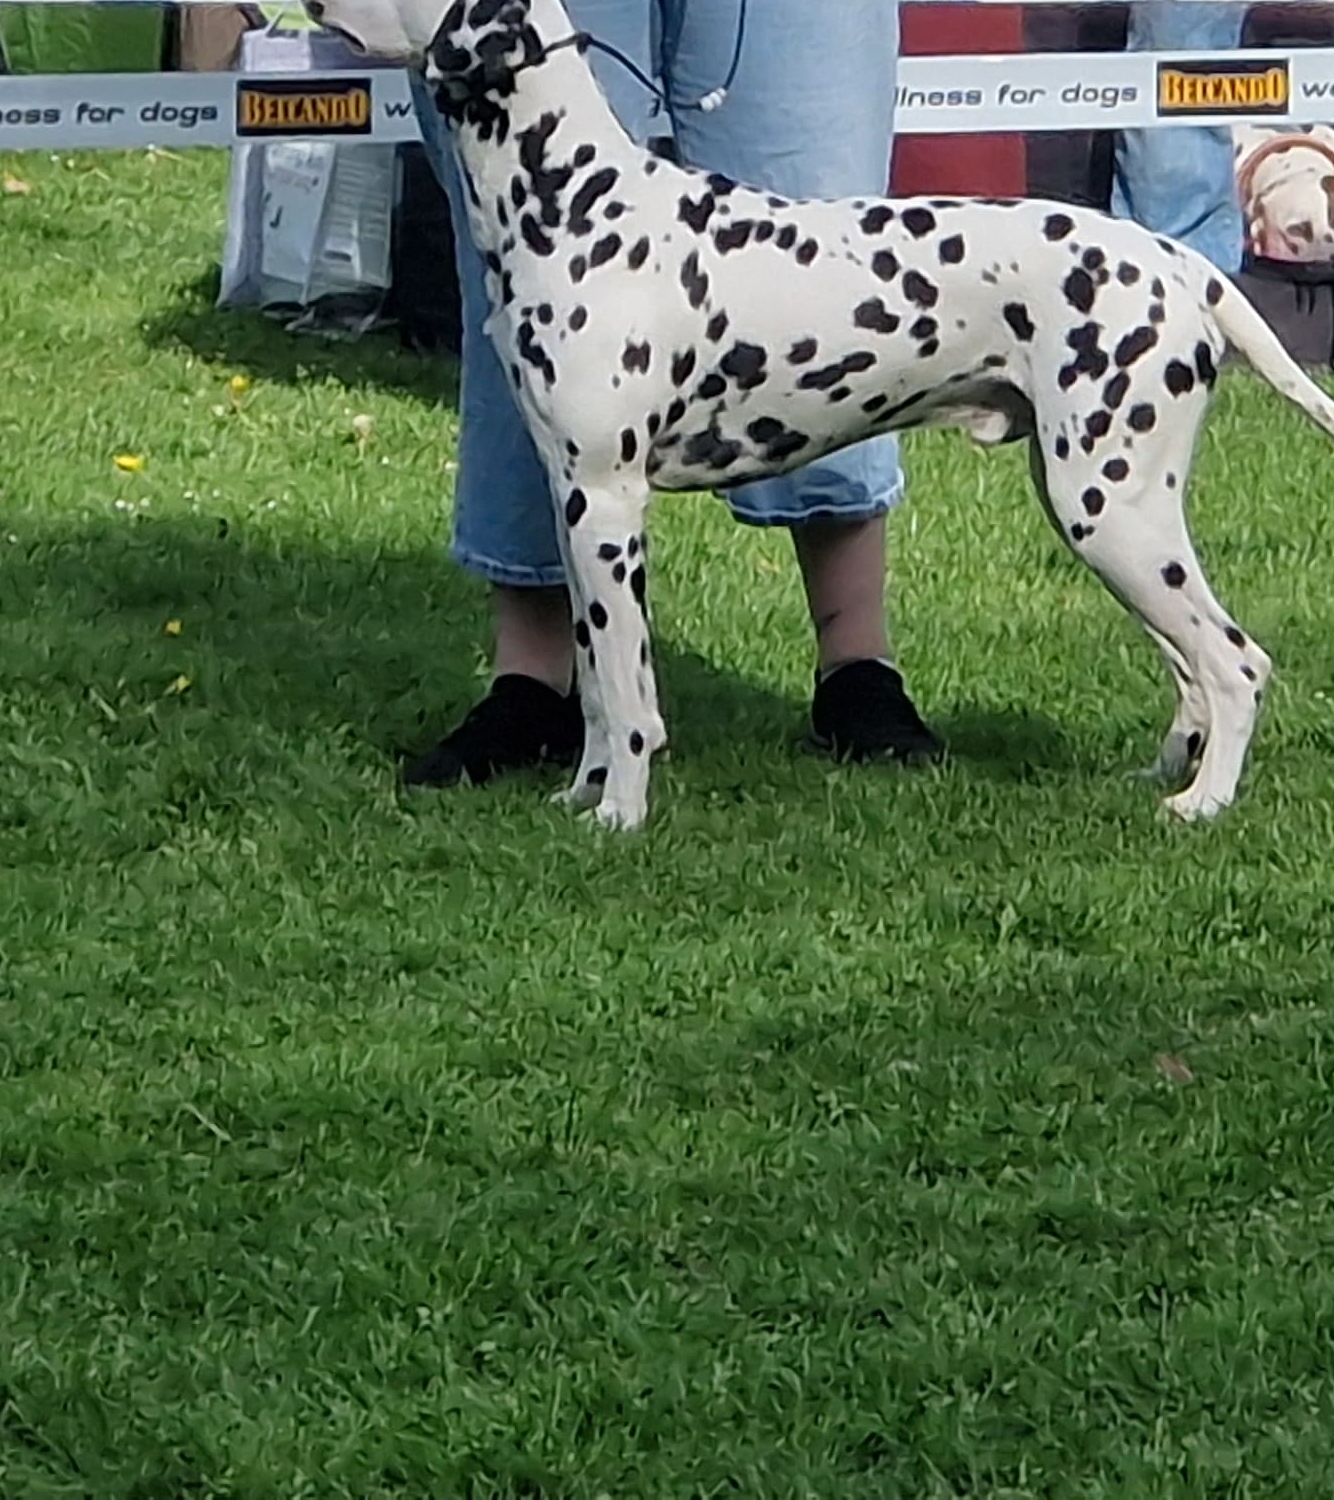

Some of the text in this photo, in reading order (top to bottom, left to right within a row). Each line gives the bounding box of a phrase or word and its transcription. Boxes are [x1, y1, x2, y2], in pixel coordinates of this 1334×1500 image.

[894, 85, 984, 107] llness
[997, 84, 1047, 106] for
[1061, 82, 1139, 108] dogs
[1160, 68, 1287, 108] BELCANDO
[75, 101, 125, 124] for
[139, 99, 220, 128] dogs
[244, 89, 368, 125] BELCANDO
